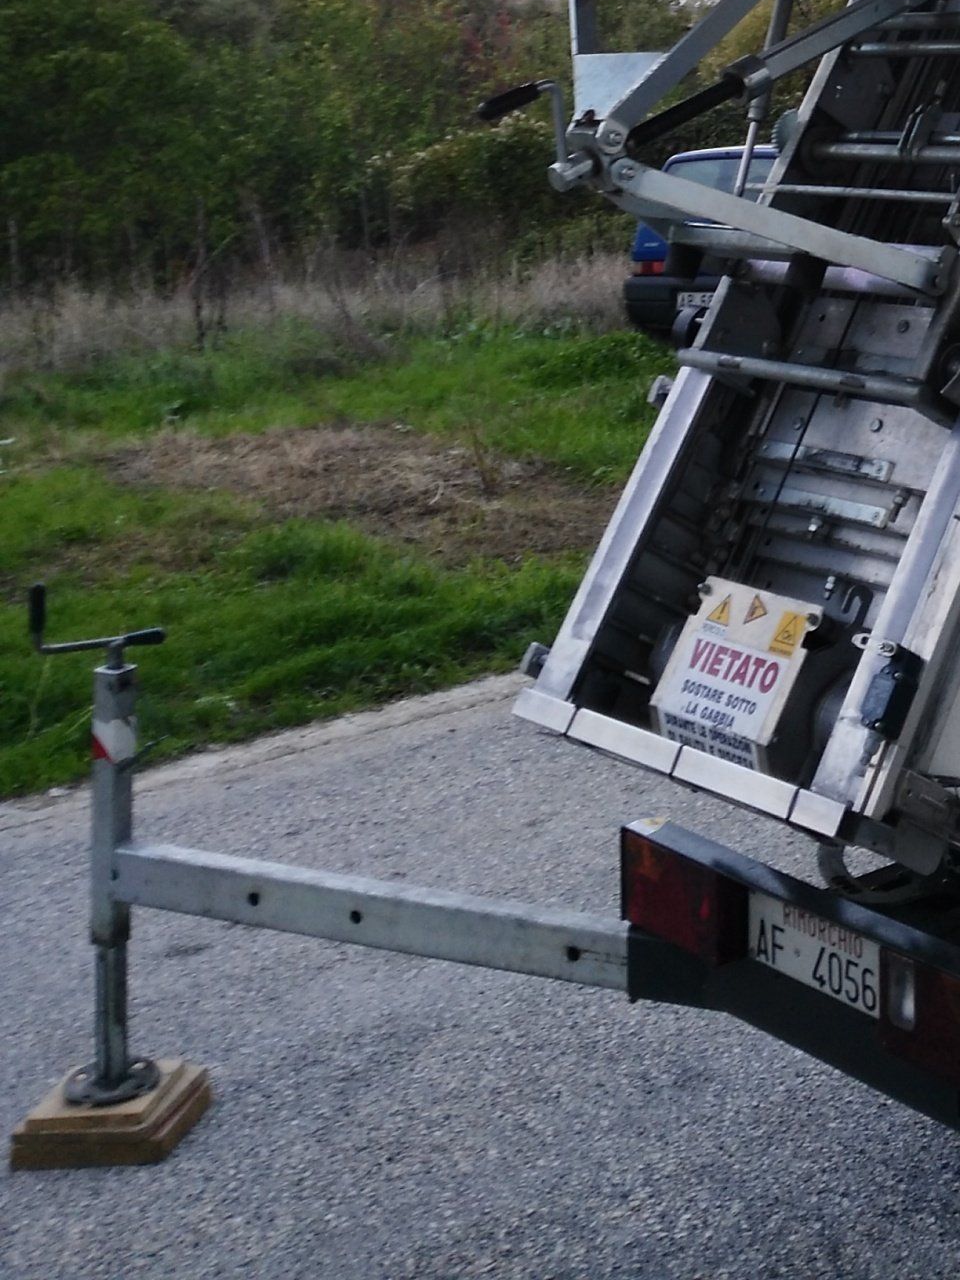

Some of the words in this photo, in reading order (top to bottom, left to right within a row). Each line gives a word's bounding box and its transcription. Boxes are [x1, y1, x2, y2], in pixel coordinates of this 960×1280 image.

[689, 638, 779, 694] VIETATO
[682, 679, 725, 704] SOSTARE
[725, 694, 757, 715] SOTTO
[685, 701, 699, 716] LA
[757, 918, 785, 965] AF
[812, 947, 877, 1012] 4056
